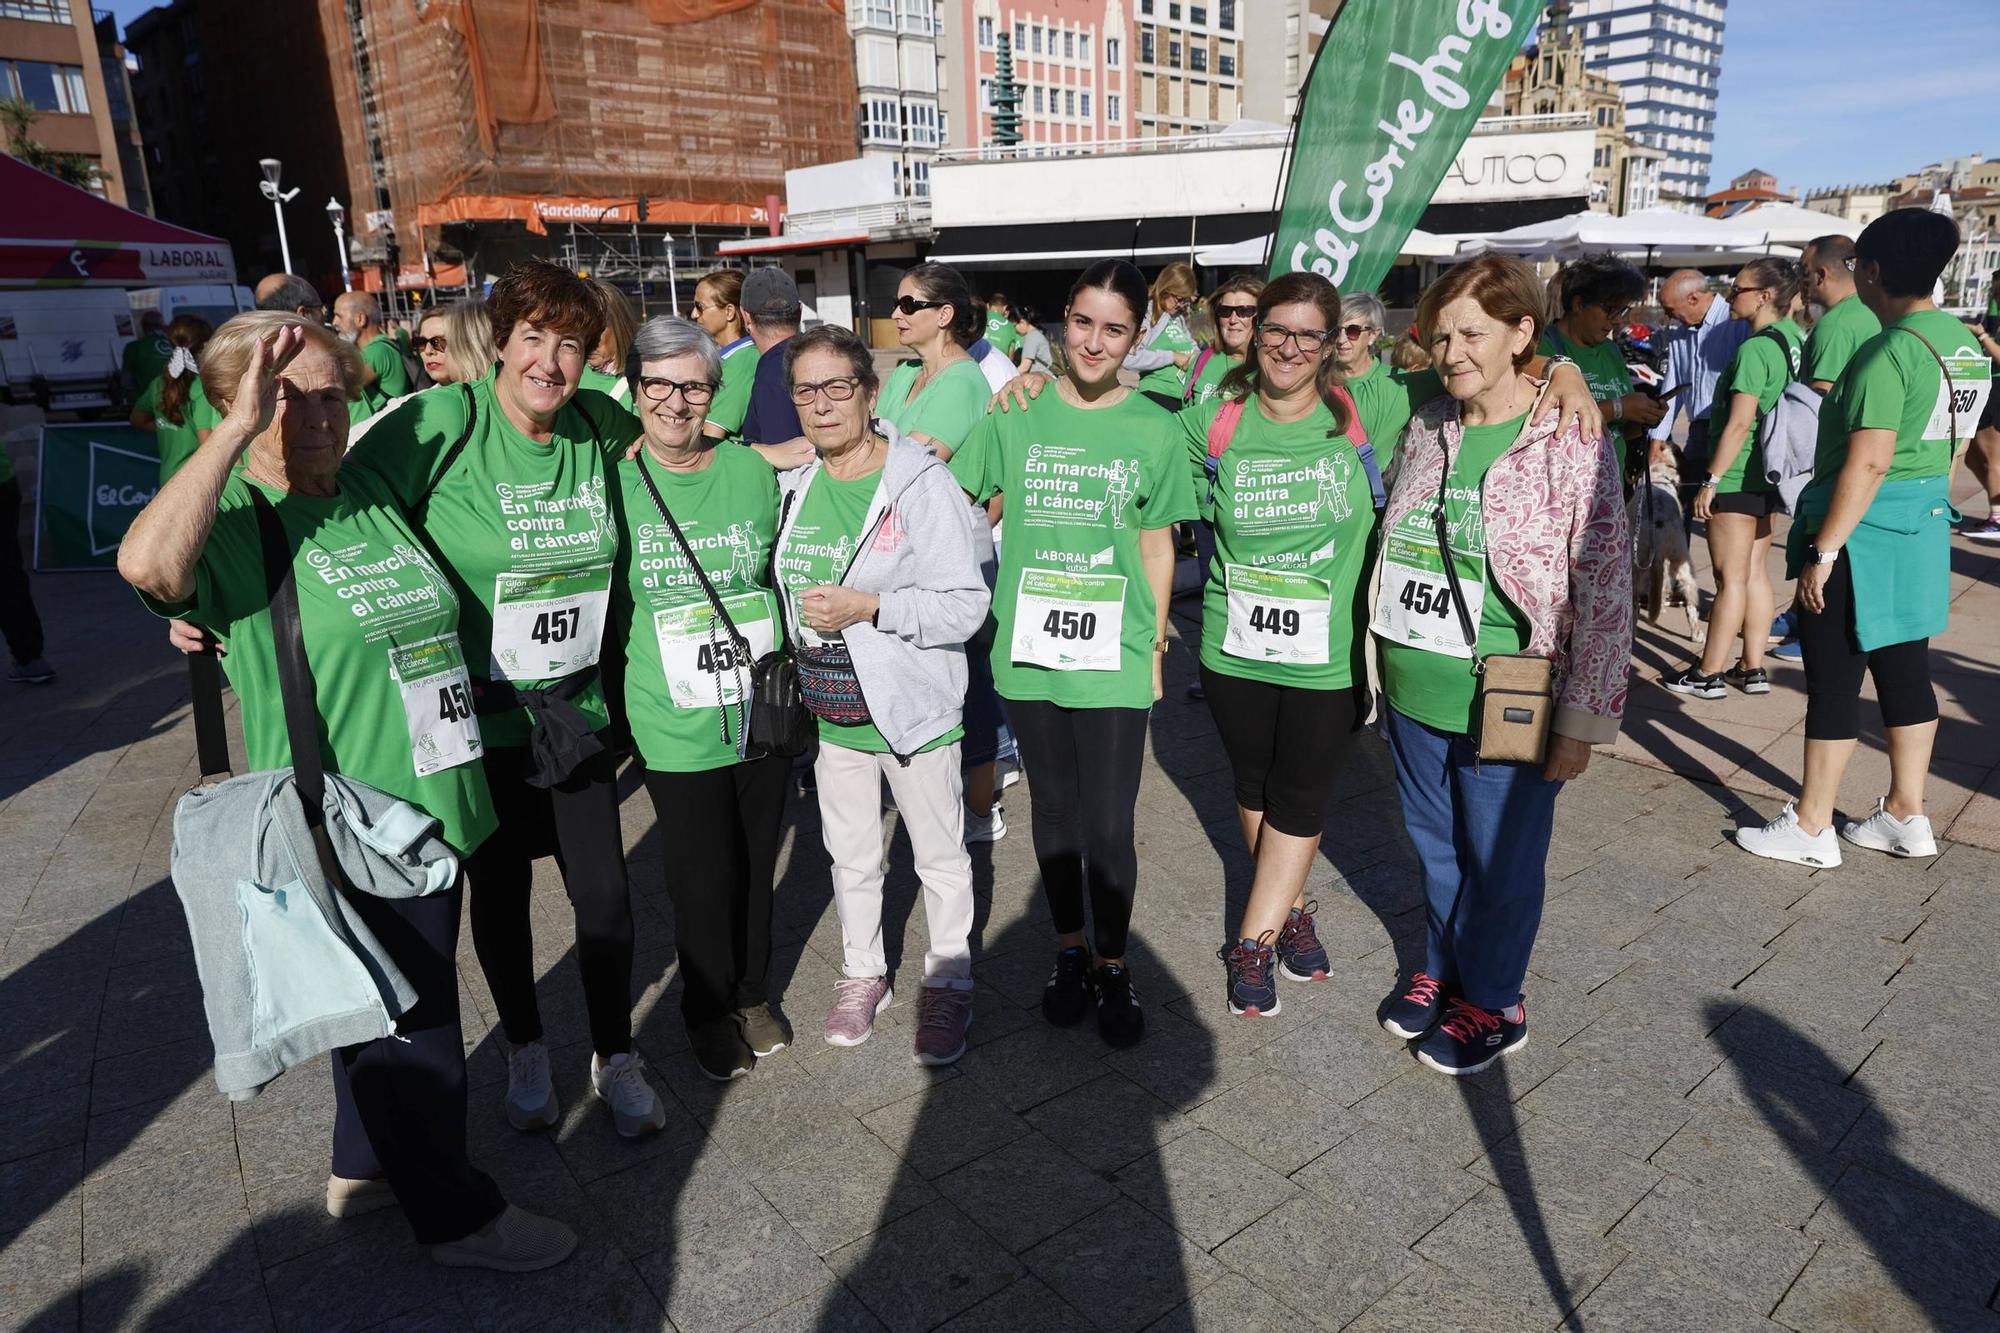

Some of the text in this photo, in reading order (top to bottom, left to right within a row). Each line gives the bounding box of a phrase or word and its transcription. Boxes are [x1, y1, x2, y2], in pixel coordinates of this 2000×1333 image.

[1329, 99, 1434, 234] Corte
[150, 249, 223, 267] LABORAL
[1948, 389, 1978, 413] 650
[1025, 458, 1119, 479] En marcha
[1235, 466, 1326, 487] En marcha
[1024, 478, 1079, 493] contra
[1234, 488, 1289, 502] contra
[500, 494, 592, 514] En marcha
[1025, 491, 1104, 511] el cáncer
[1234, 500, 1316, 518] el cáncer
[506, 516, 566, 532] contra
[510, 530, 597, 550] el cáncer
[638, 539, 664, 554] En
[795, 542, 842, 559] marcha
[1035, 549, 1089, 563] LABORAL
[1252, 552, 1308, 565] LABORAL
[779, 557, 812, 571] ontra
[1066, 564, 1088, 573] kutxa
[317, 565, 355, 585] En
[505, 579, 527, 588] Gijón
[642, 572, 660, 588] el
[336, 576, 400, 599] contra
[351, 597, 375, 617] el
[376, 585, 435, 610] cáncer
[1399, 579, 1451, 619] 454
[531, 607, 580, 645] 457
[1043, 609, 1097, 641] 450
[1249, 605, 1300, 636] 449
